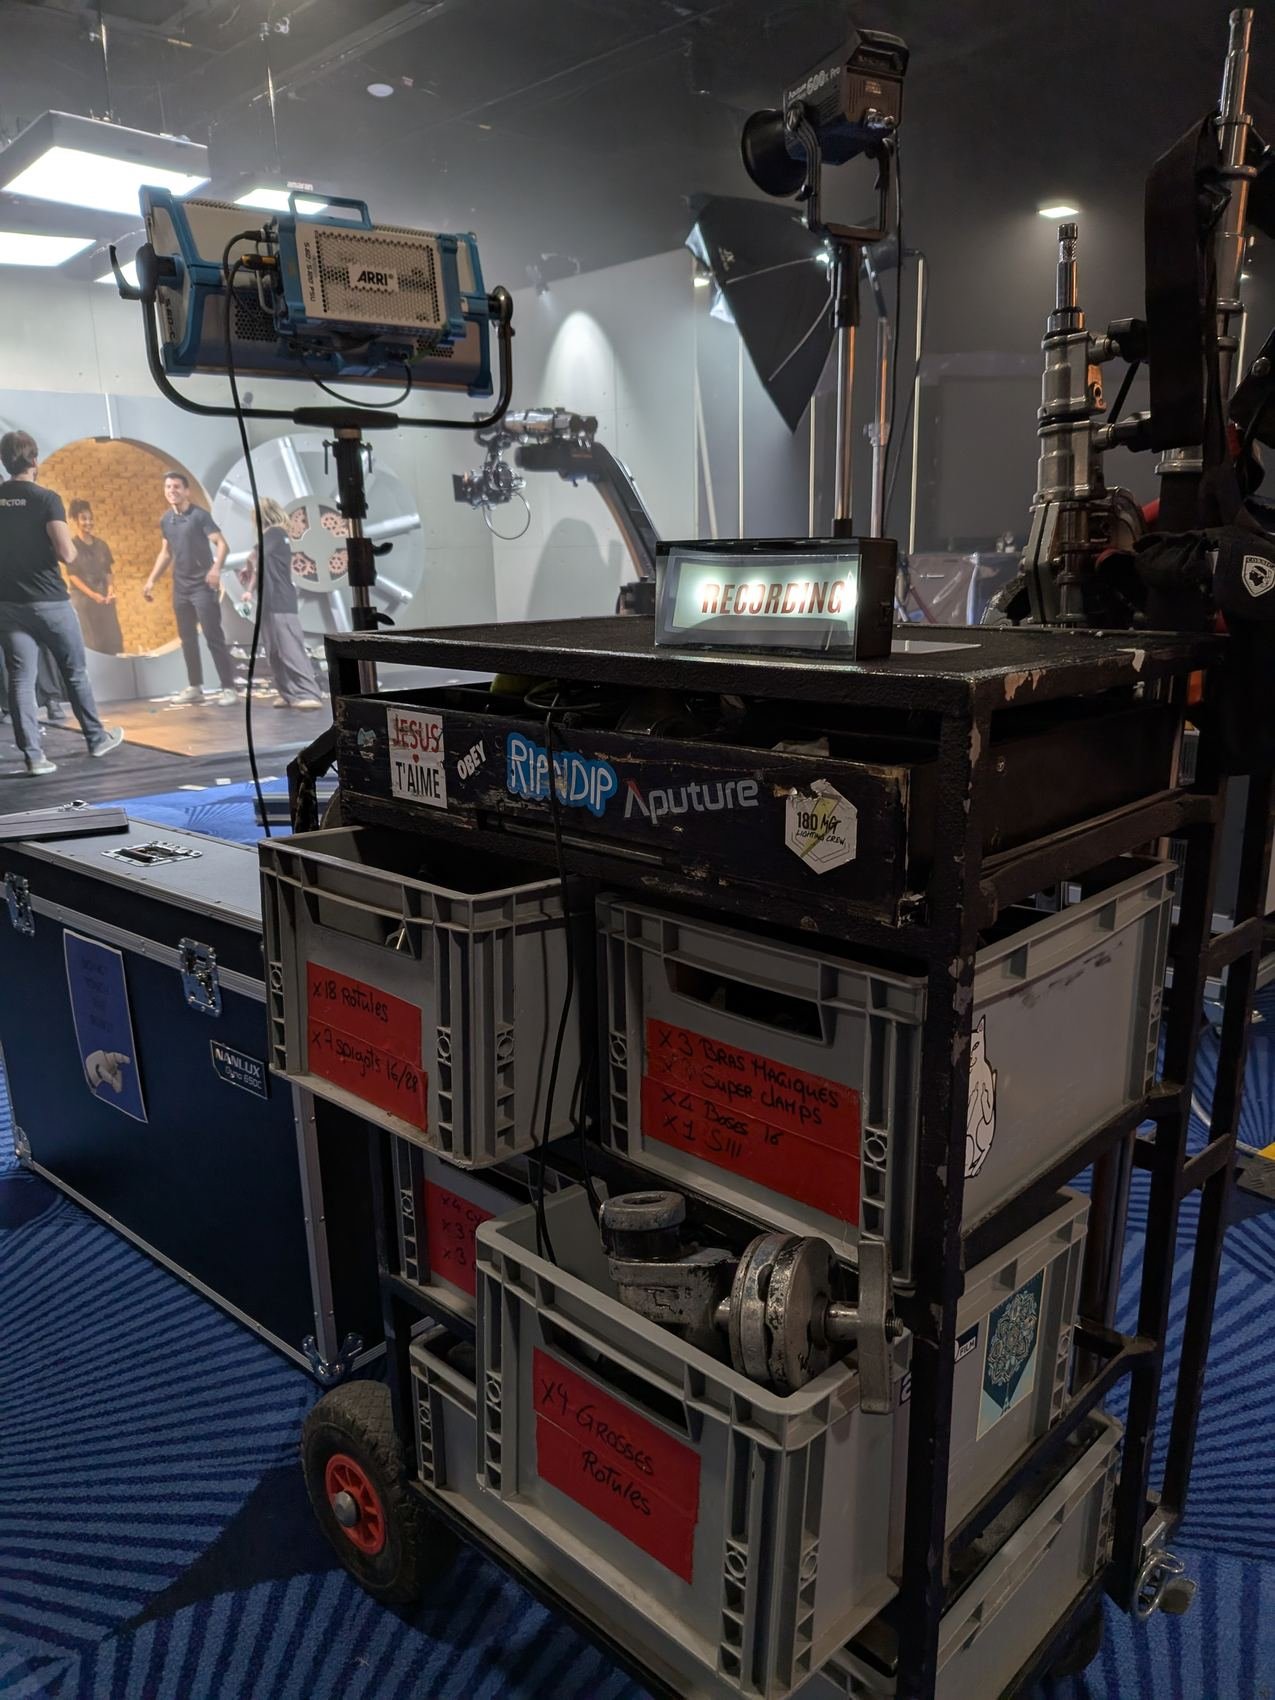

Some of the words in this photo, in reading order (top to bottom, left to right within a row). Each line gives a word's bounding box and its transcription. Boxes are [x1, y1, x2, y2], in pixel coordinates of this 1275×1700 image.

[357, 270, 390, 287] ARRI
[701, 579, 846, 615] RECORDING
[391, 715, 440, 754] JESUS
[457, 740, 487, 780] OBEY
[396, 761, 441, 799] T'AIME
[826, 835, 847, 846] CREW
[215, 1047, 260, 1078] NANLUX
